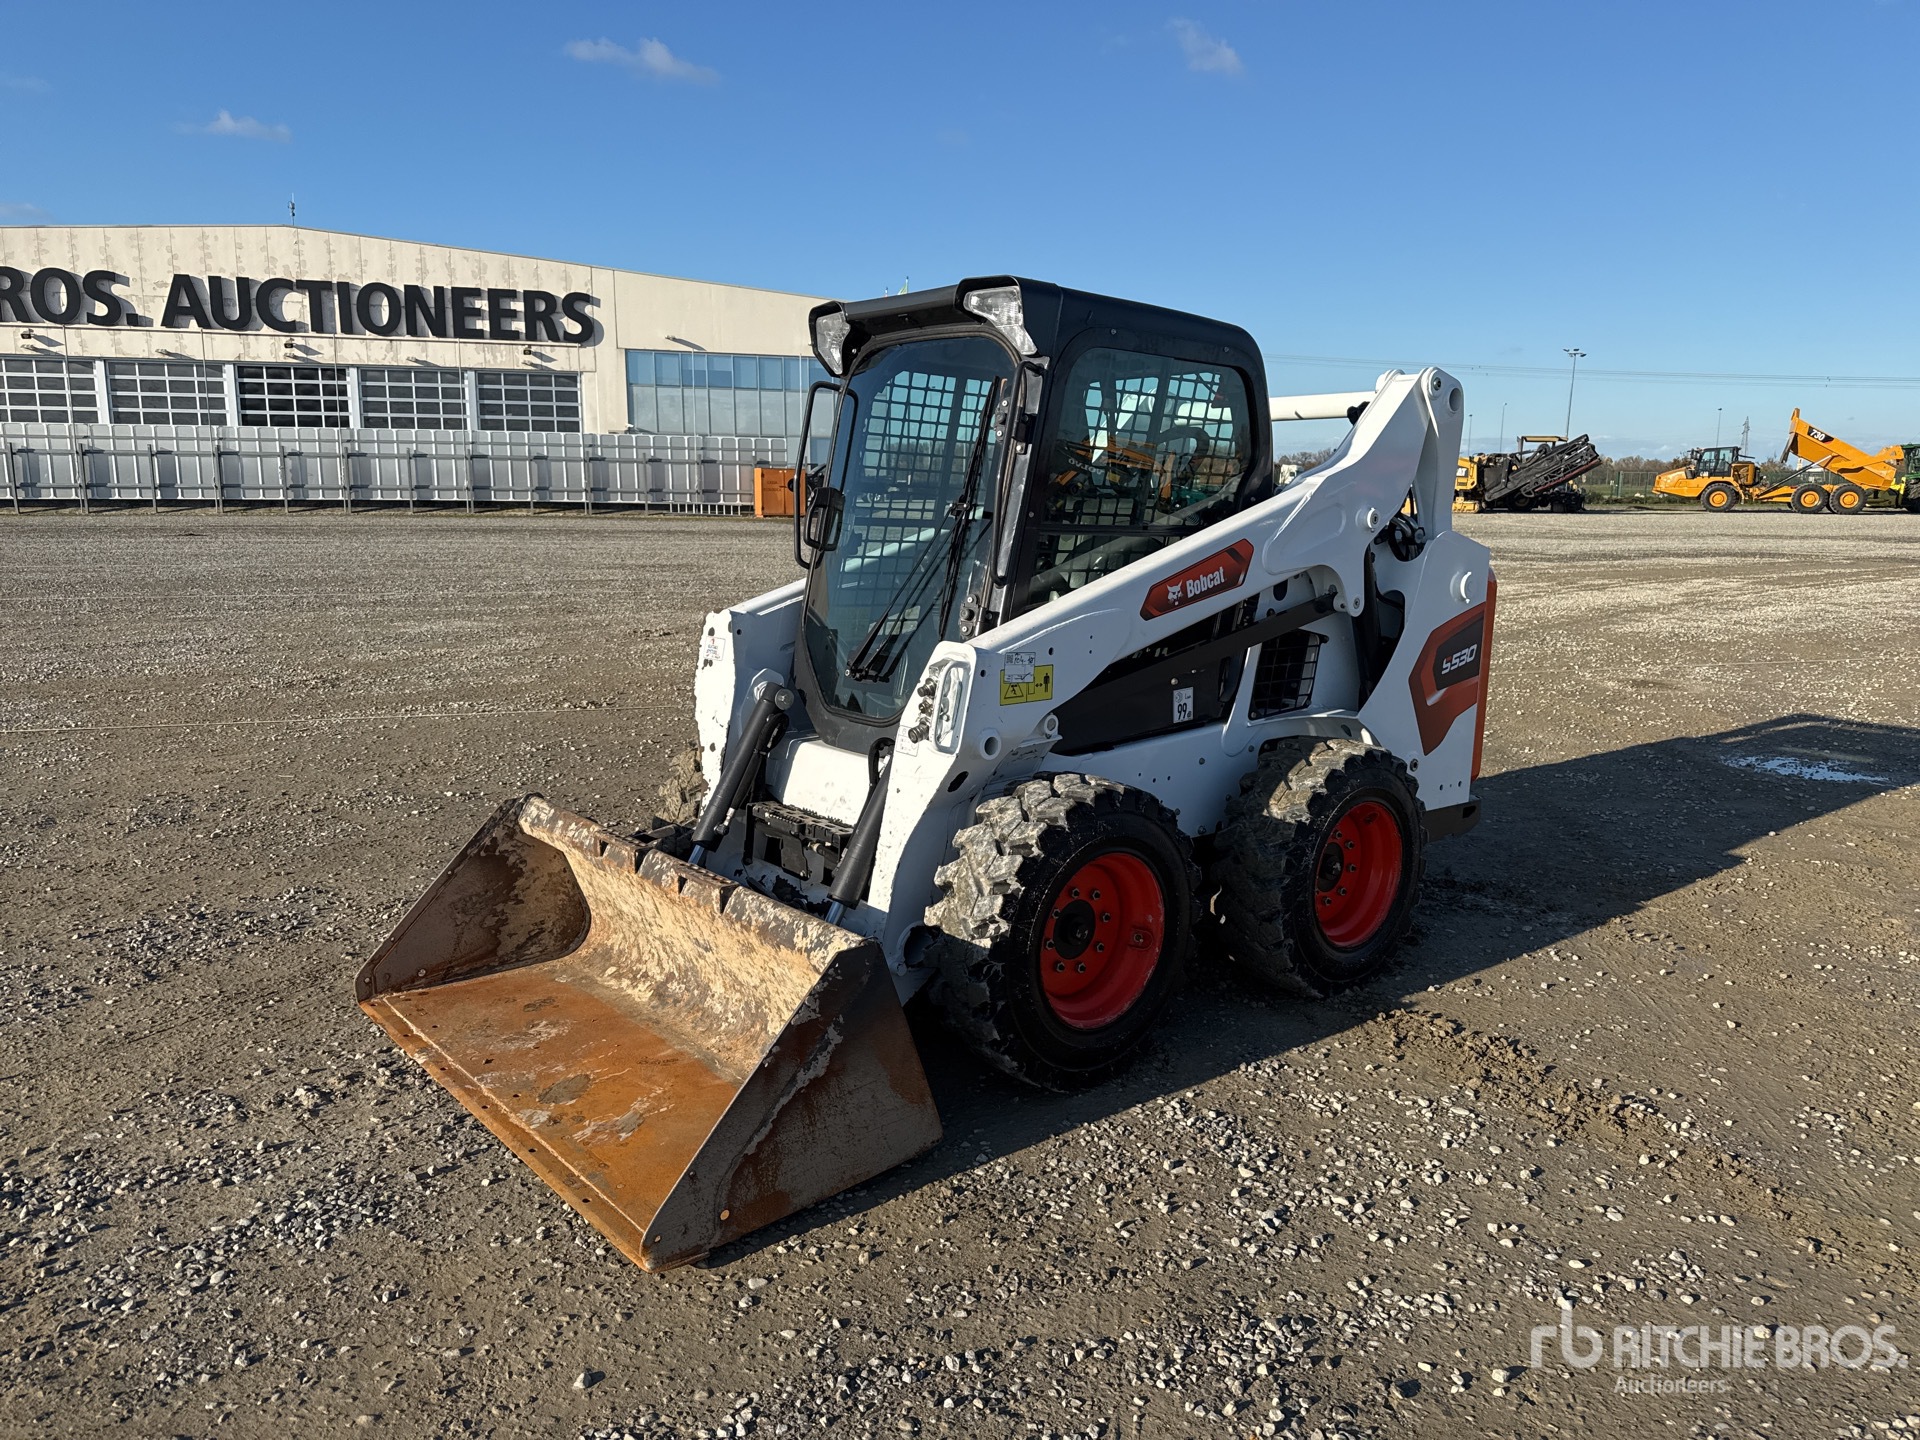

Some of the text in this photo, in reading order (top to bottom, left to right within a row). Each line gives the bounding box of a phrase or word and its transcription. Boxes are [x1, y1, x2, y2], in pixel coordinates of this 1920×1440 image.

[160, 273, 594, 343] AUCTIONEERS
[1810, 428, 1825, 441] 730
[1186, 566, 1225, 598] Bobcat
[1441, 643, 1478, 675] S530
[1177, 702, 1187, 720] 99
